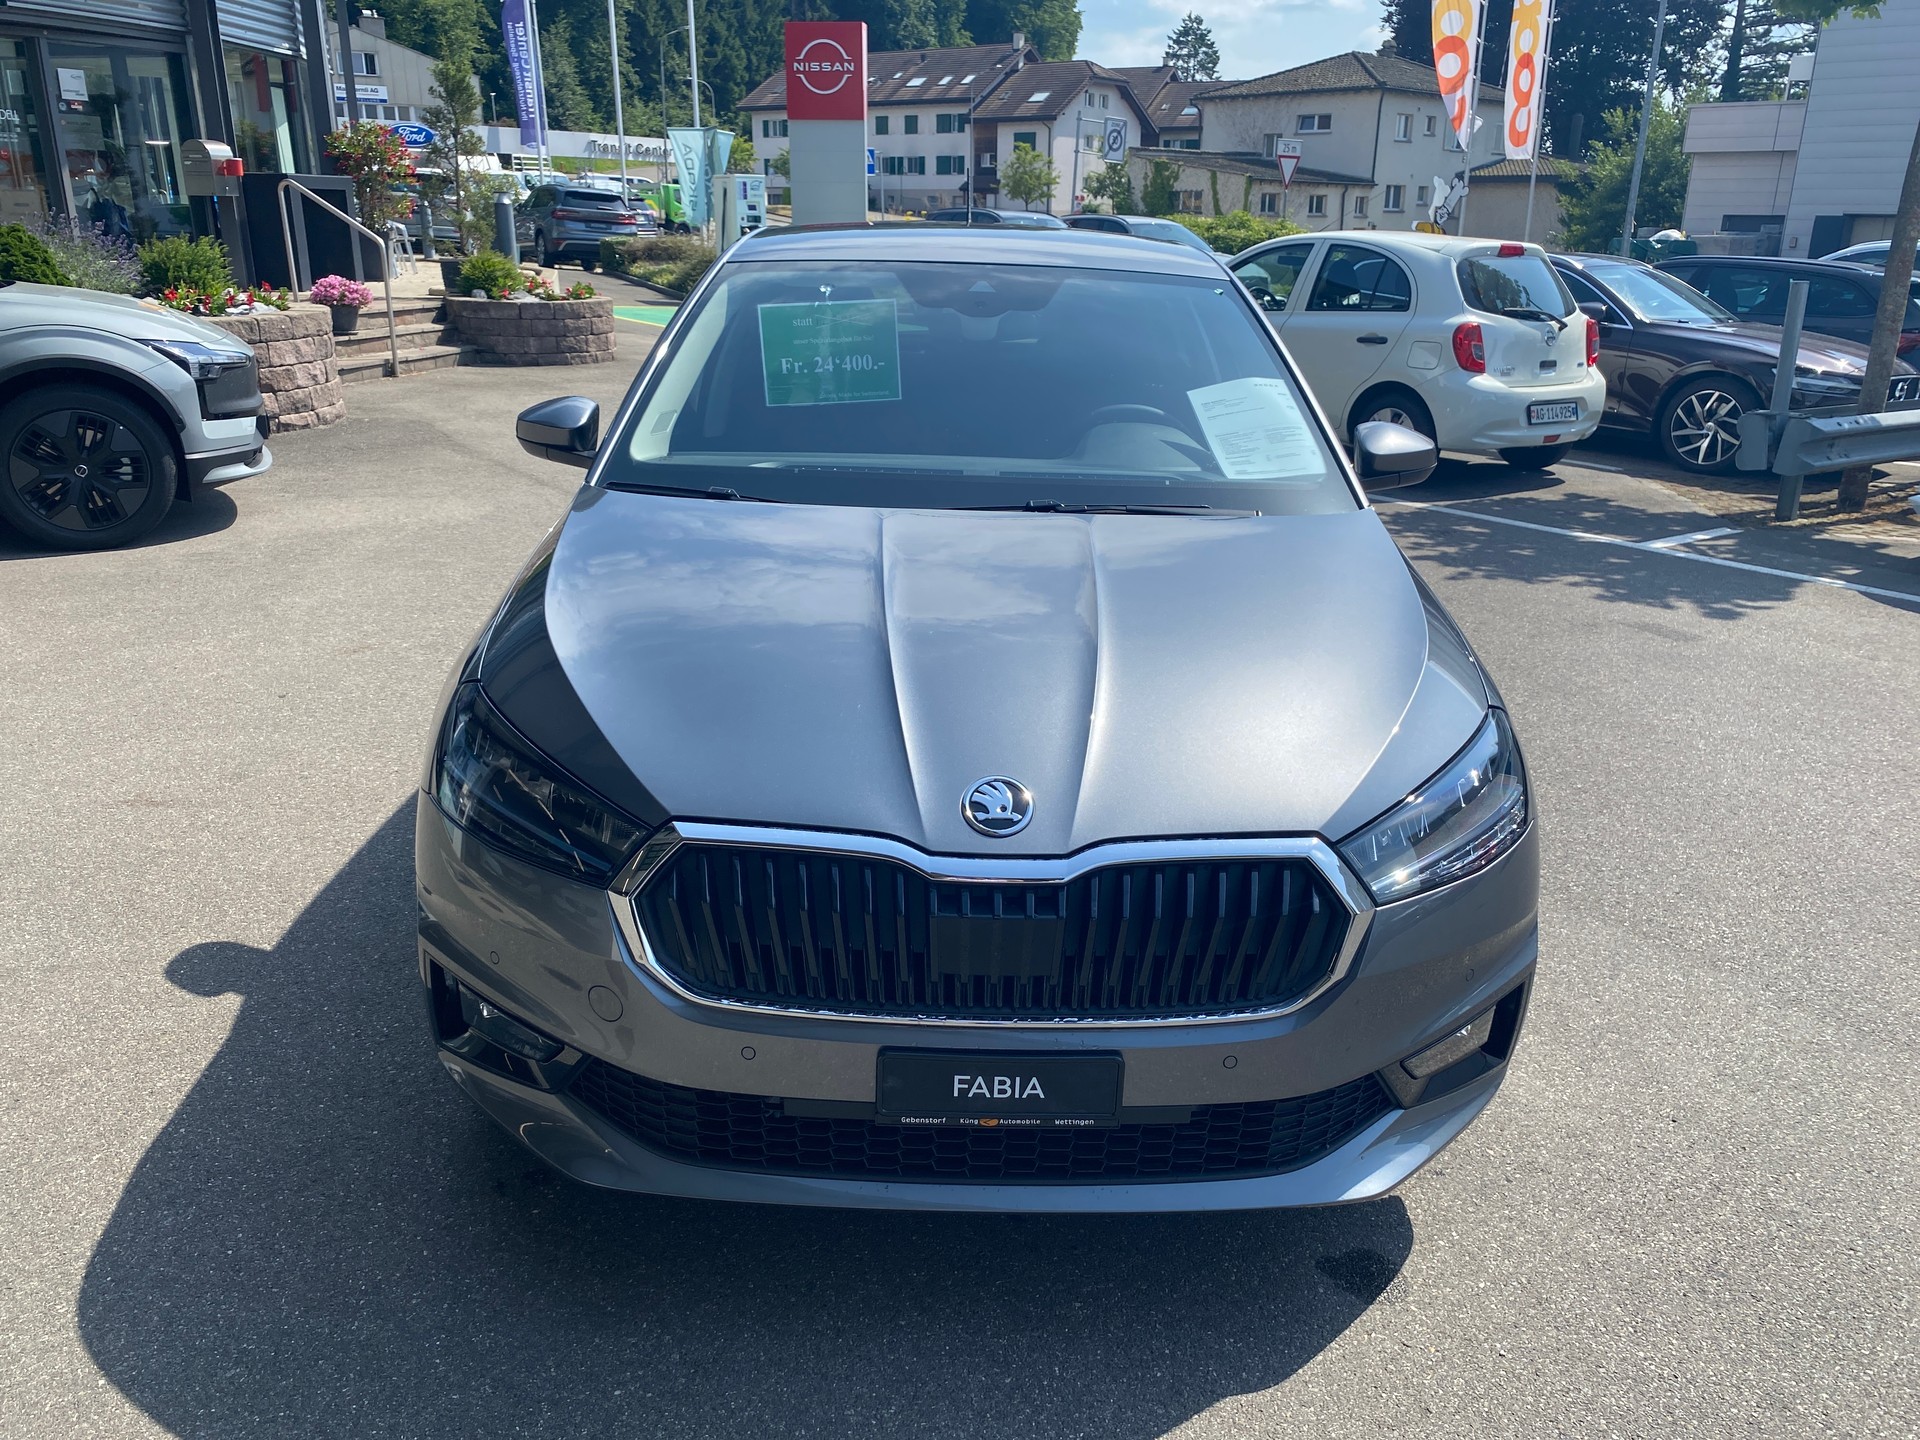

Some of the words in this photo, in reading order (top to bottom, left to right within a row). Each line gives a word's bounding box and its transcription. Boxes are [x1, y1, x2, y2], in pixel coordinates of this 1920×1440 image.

[793, 62, 855, 71] NISSAN
[398, 126, 426, 142] Ford
[635, 143, 674, 156] Center
[1282, 143, 1290, 153] 25
[792, 317, 813, 327] statt
[780, 358, 808, 374] Fr.
[953, 1074, 1046, 1099] FABIA
[901, 1116, 947, 1124] Gebenstorf
[960, 1117, 979, 1126] Küng
[1054, 1118, 1095, 1126] Wettingen
